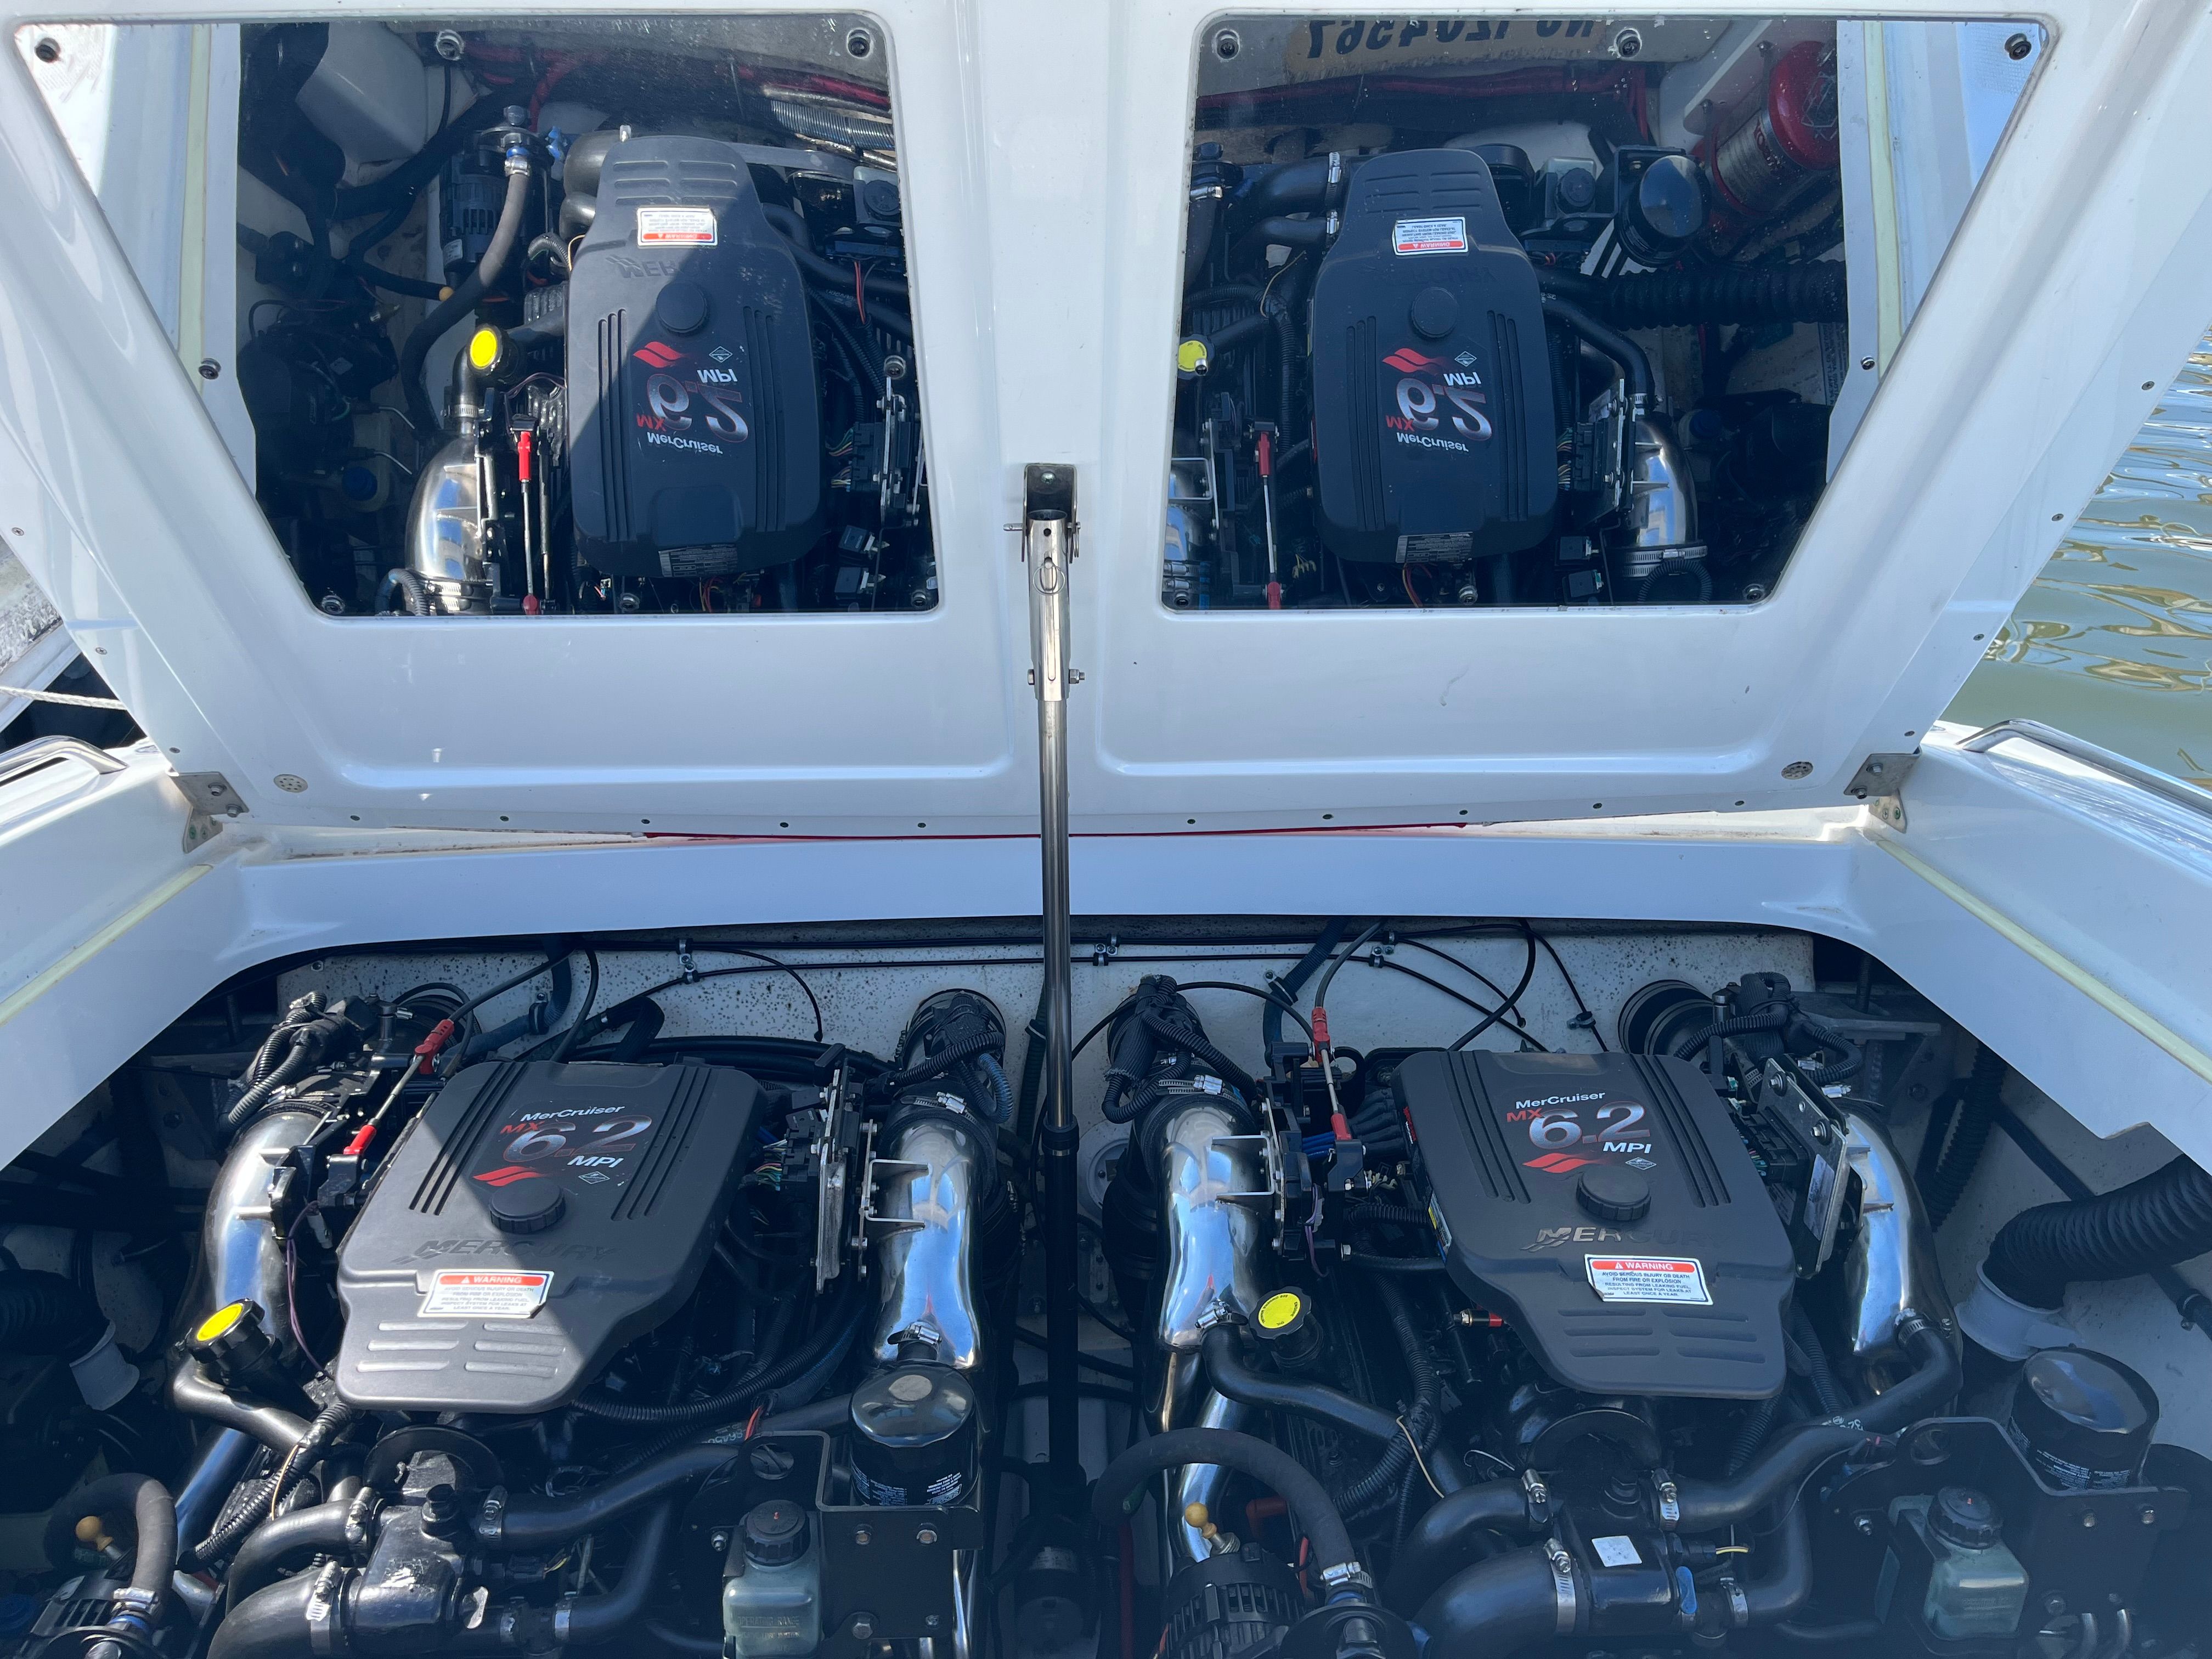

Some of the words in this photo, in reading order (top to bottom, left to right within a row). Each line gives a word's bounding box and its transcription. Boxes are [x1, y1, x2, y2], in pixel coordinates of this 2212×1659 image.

[1515, 1091, 1606, 1110] MerCruiser
[520, 1105, 625, 1122] MerCruiser
[500, 1121, 545, 1135] MX
[1506, 1108, 1543, 1123] MX
[1528, 1101, 1650, 1149] 6.2
[503, 1115, 652, 1163] 6.2
[1602, 1142, 1652, 1154] MPI
[567, 1155, 624, 1168] MPI
[1625, 1262, 1674, 1270] WARNING
